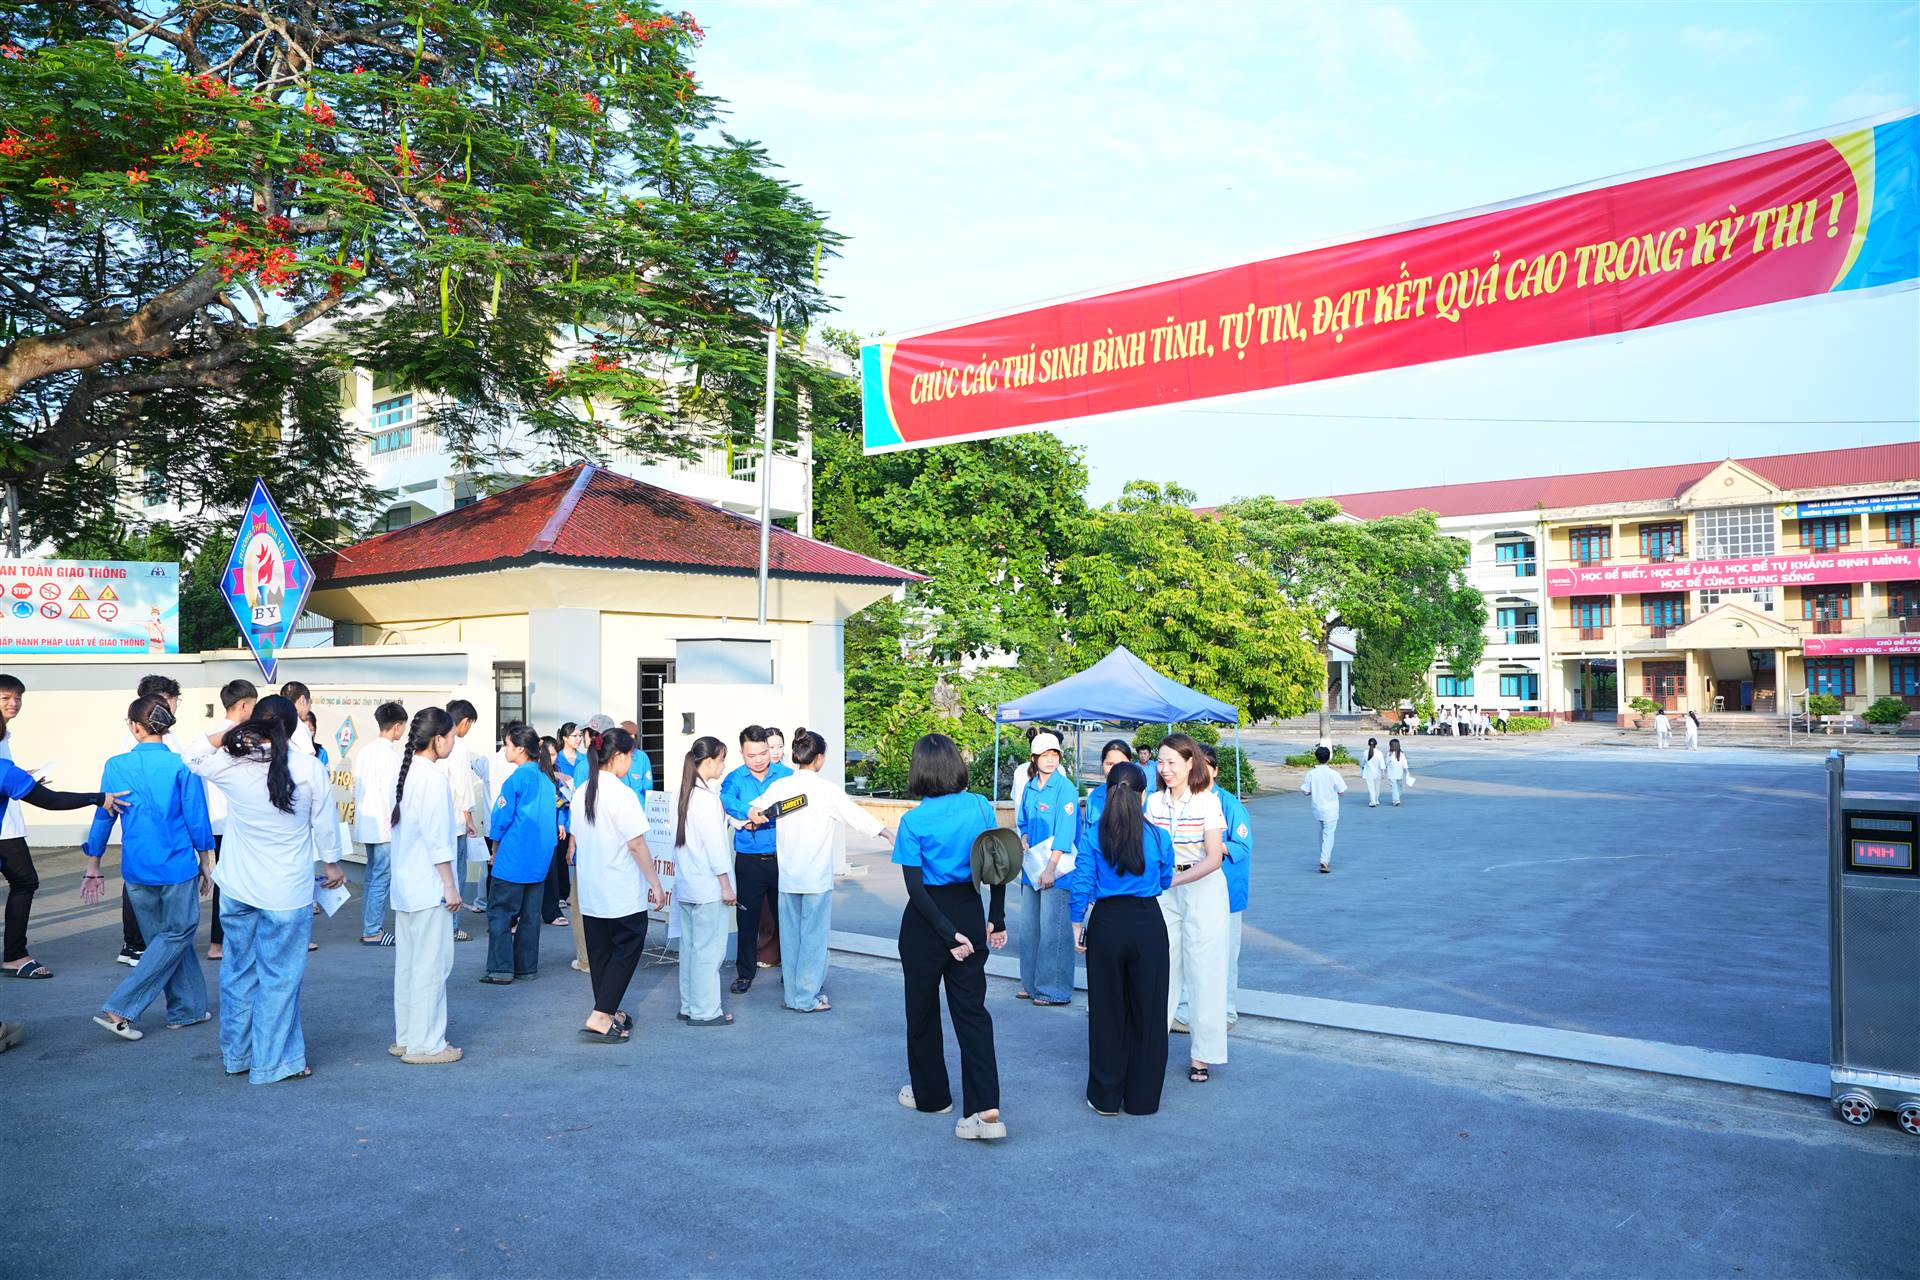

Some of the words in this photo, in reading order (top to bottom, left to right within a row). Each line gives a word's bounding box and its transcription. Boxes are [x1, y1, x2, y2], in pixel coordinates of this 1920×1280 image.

[910, 361, 959, 405] CHÚC
[961, 353, 999, 396] CÁC
[1002, 343, 1036, 389] THÍ
[1039, 343, 1089, 383] SINH
[1092, 328, 1146, 374] BÌNH
[1150, 316, 1215, 363] TĨNH,
[1219, 303, 1256, 360] TỰ
[1258, 301, 1308, 344] TIN,
[1312, 288, 1371, 343] ĐẠT
[1374, 261, 1433, 324] KẾT
[1435, 250, 1501, 322] QUẢ
[1504, 250, 1568, 301] CAO
[1573, 227, 1687, 288] TRONG
[1691, 205, 1745, 266] KỲ
[1752, 199, 1817, 253] THI
[21, 564, 53, 577] TOÀN
[57, 567, 84, 578] GIAO
[88, 565, 127, 579] THÔNG
[1581, 572, 1603, 582] HỌC
[1604, 568, 1619, 579] ĐỂ
[1622, 566, 1648, 579] BIẾT,
[1651, 568, 1673, 578] HỌC
[1676, 564, 1691, 576] ĐỂ
[1693, 563, 1722, 575] LÀM,
[1726, 564, 1749, 574] HỌC
[1752, 558, 1768, 571] ĐỂ
[1771, 560, 1788, 572] TỰ
[1791, 556, 1834, 569] KHẲNG
[1837, 557, 1869, 570] ĐỊNH
[1872, 554, 1911, 566] MÌNH,
[1661, 579, 1684, 589] HỌC
[1686, 575, 1701, 587] ĐỂ
[1704, 575, 1735, 587] CÙNG
[1738, 574, 1778, 585] CHUNG
[1781, 570, 1815, 582] SỐNG
[13, 587, 31, 595] STOP
[100, 638, 117, 646] GIAO
[120, 637, 145, 647] THÔNG
